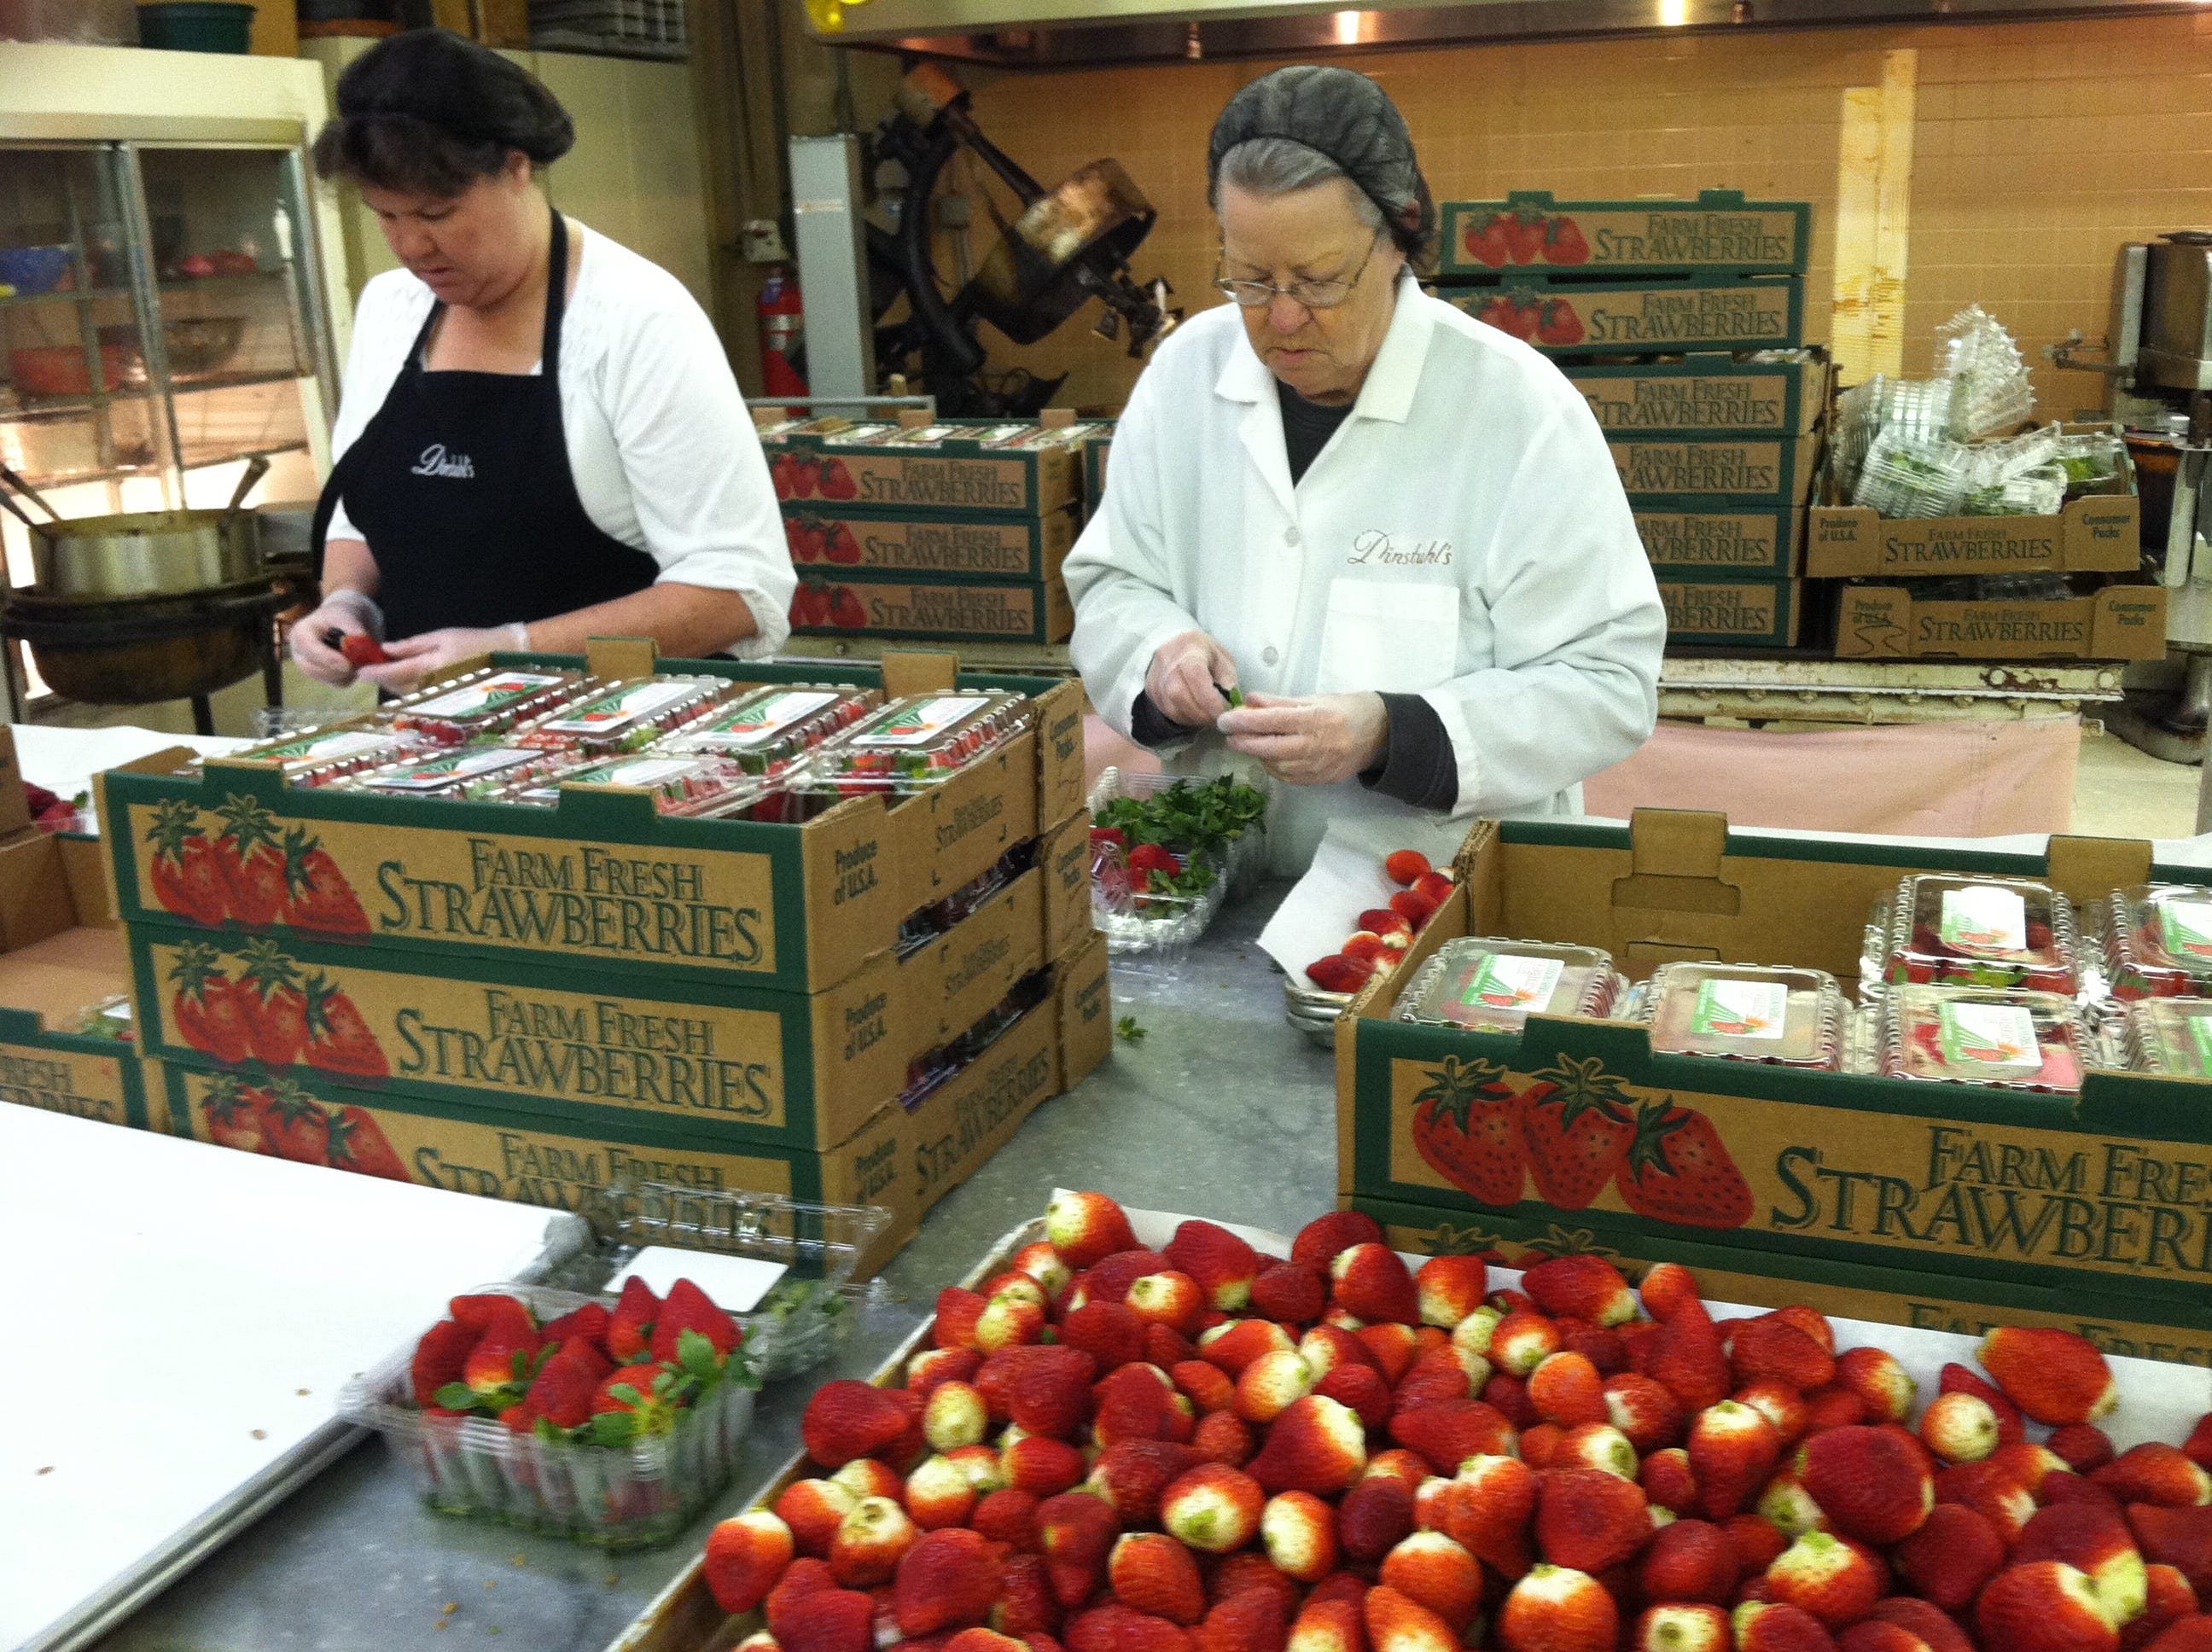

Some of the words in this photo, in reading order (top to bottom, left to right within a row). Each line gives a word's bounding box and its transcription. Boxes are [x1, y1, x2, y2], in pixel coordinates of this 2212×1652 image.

[1646, 213, 1698, 238] FARM
[1705, 214, 1764, 238] FRESH
[1594, 228, 1789, 262] STRAWBERRIES
[1643, 293, 1692, 317] FARM
[1698, 290, 1757, 315] FRESH
[1589, 307, 1783, 341] STRAWBERRIES
[1633, 380, 1686, 404] FARM
[1691, 379, 1751, 401] FRESH
[1628, 445, 1682, 470] FARM
[1686, 445, 1748, 467] FRESH
[860, 470, 1022, 504] STRAWBERRIES
[1638, 519, 1679, 538] ARM
[1684, 516, 1743, 538] FRESH
[865, 536, 1024, 569] STRAWBERRIES
[1885, 537, 2052, 563] STRAWBERRIES
[1683, 585, 1742, 607] FRESH
[870, 597, 1027, 631] STRAWBERRIES
[1918, 615, 2083, 642] STRAWBERRIES
[467, 838, 575, 894] FARM
[580, 846, 706, 902] FRESH
[377, 860, 764, 965] STRAWBERRIES
[484, 988, 588, 1042] FARM
[595, 1000, 715, 1056] FRESH
[395, 1008, 772, 1117] STRAWBERRIES
[498, 1132, 600, 1183] FARM
[1922, 1126, 2091, 1194] FARM
[2098, 1143, 2212, 1208] FRE
[1770, 1146, 2212, 1273] STRAWBER
